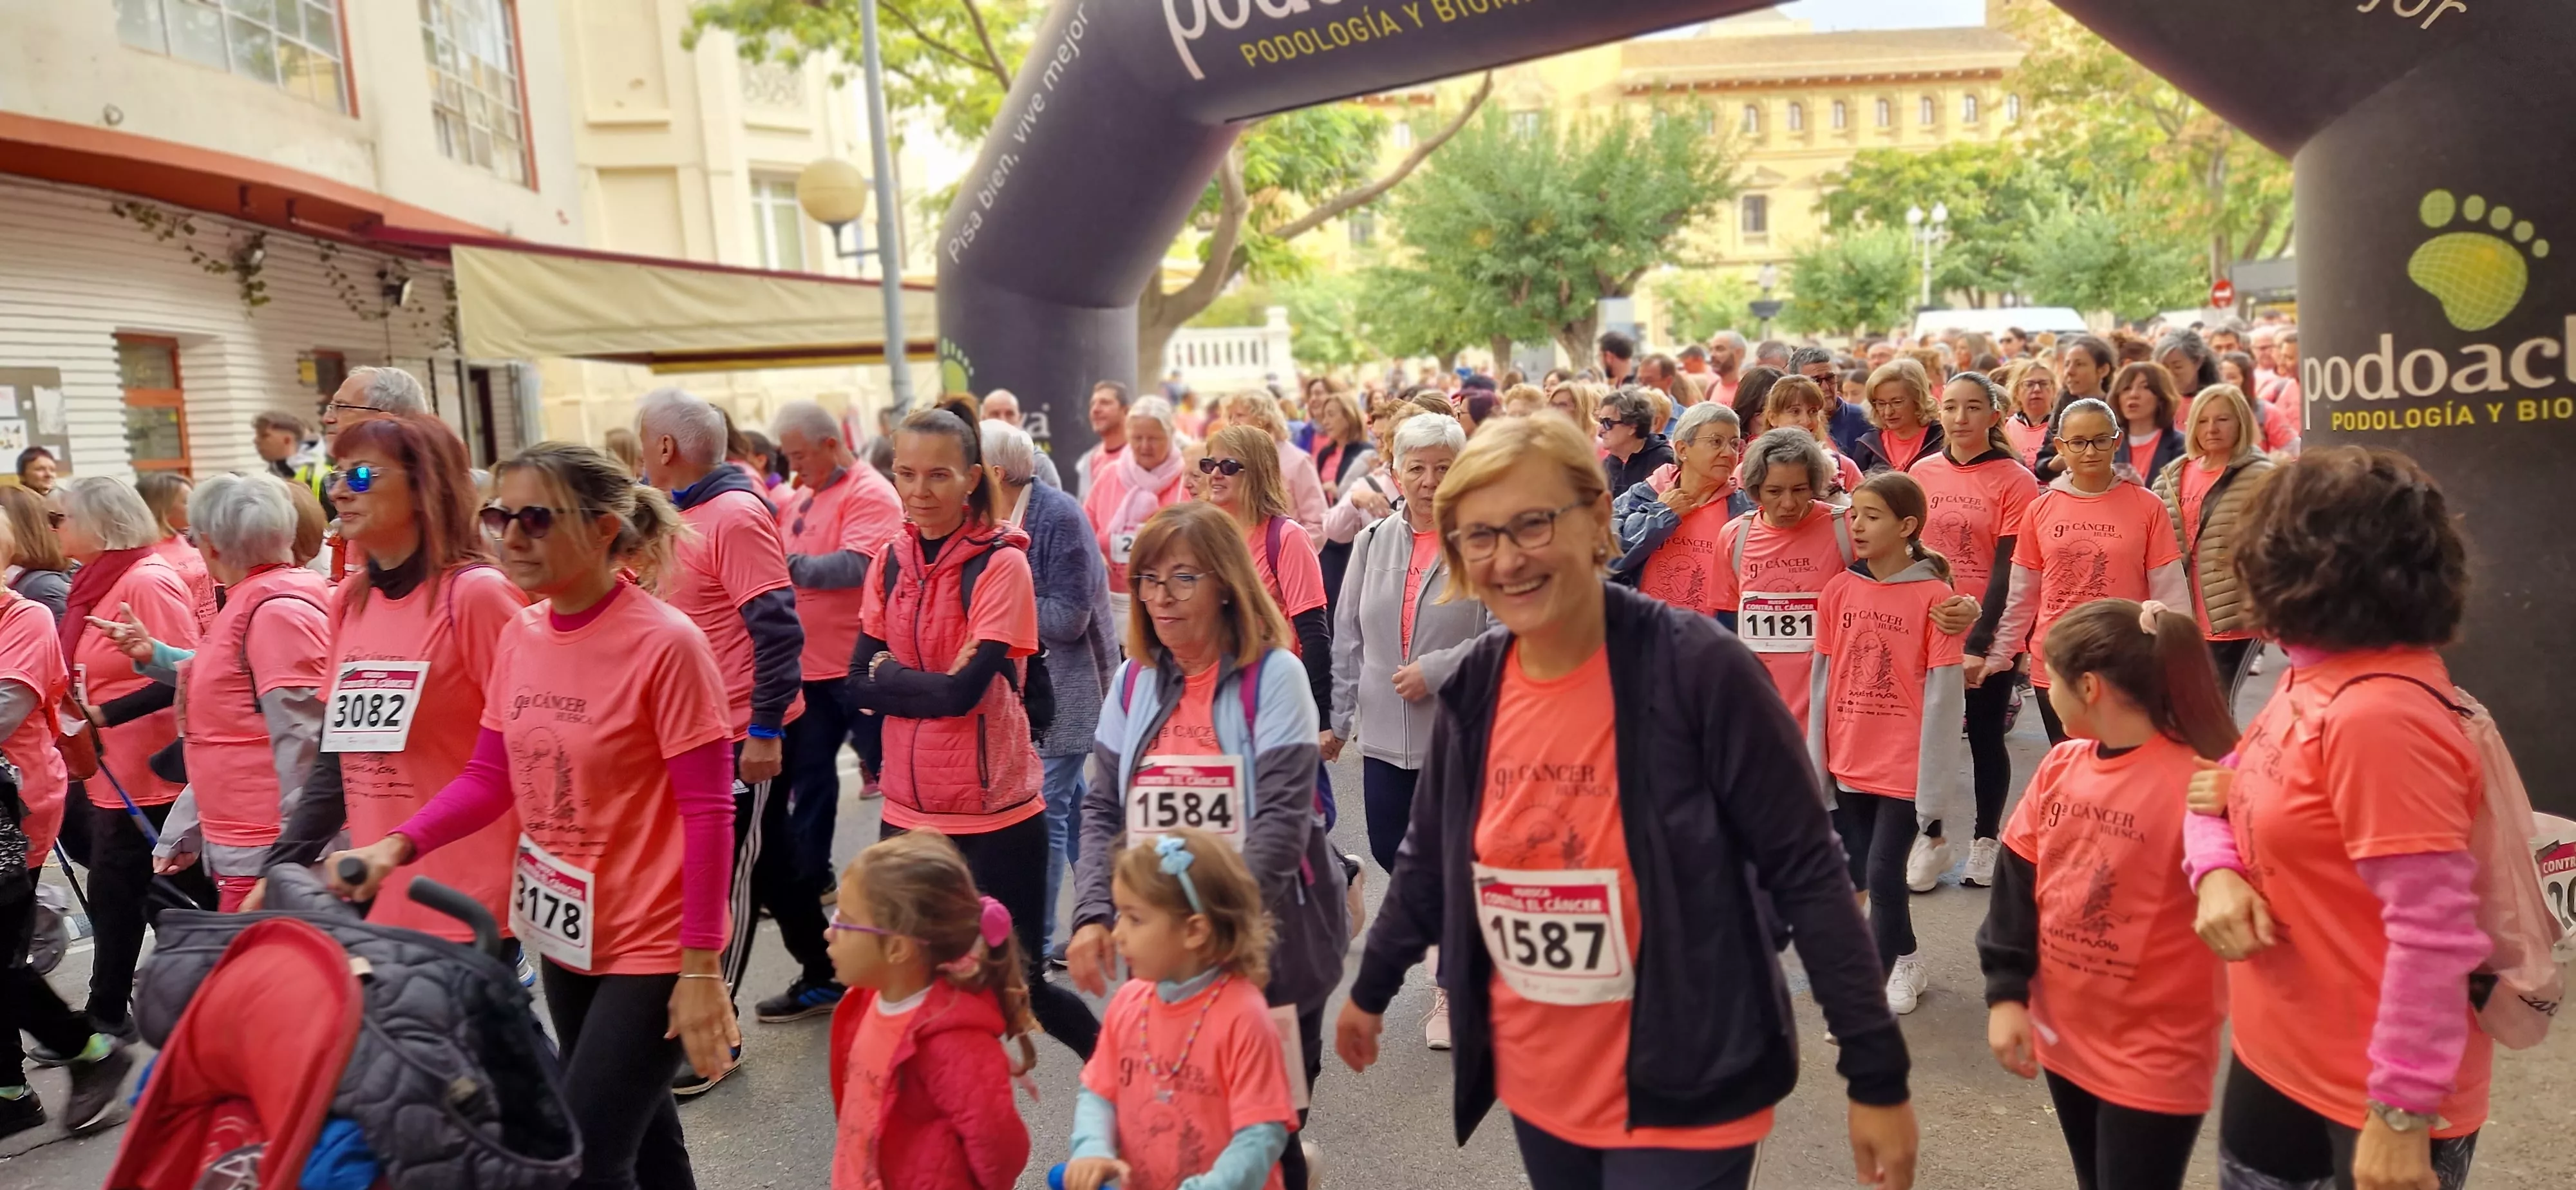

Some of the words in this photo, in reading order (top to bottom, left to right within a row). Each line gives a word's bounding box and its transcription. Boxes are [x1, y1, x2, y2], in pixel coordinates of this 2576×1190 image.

[1240, 6, 1403, 67] PODOLOGÍA
[1402, 2, 1423, 28] Y
[948, 210, 983, 264] Pisa
[978, 153, 1020, 211] bien,
[1013, 92, 1046, 143] vive
[1042, 3, 1088, 91] mejor
[2331, 401, 2476, 431] PODOLOGÍA
[2486, 402, 2504, 423] Y
[1946, 494, 1982, 505] CÁNCER
[2072, 521, 2115, 533] CÁNCER
[1672, 536, 1713, 549] CÁNCER
[1765, 557, 1810, 569] CÁNCER
[1788, 565, 1819, 574] HUESCA
[1746, 614, 1813, 637] 1181
[1859, 609, 1903, 627] CÁNCER
[1878, 622, 1909, 635] HUESCA
[334, 694, 405, 728] 3082
[1136, 792, 1232, 828] 1584
[2071, 802, 2135, 828] CÁNCER
[2100, 824, 2145, 844] HUESCA
[515, 873, 582, 940] 3178
[1490, 914, 1605, 970] 1587
